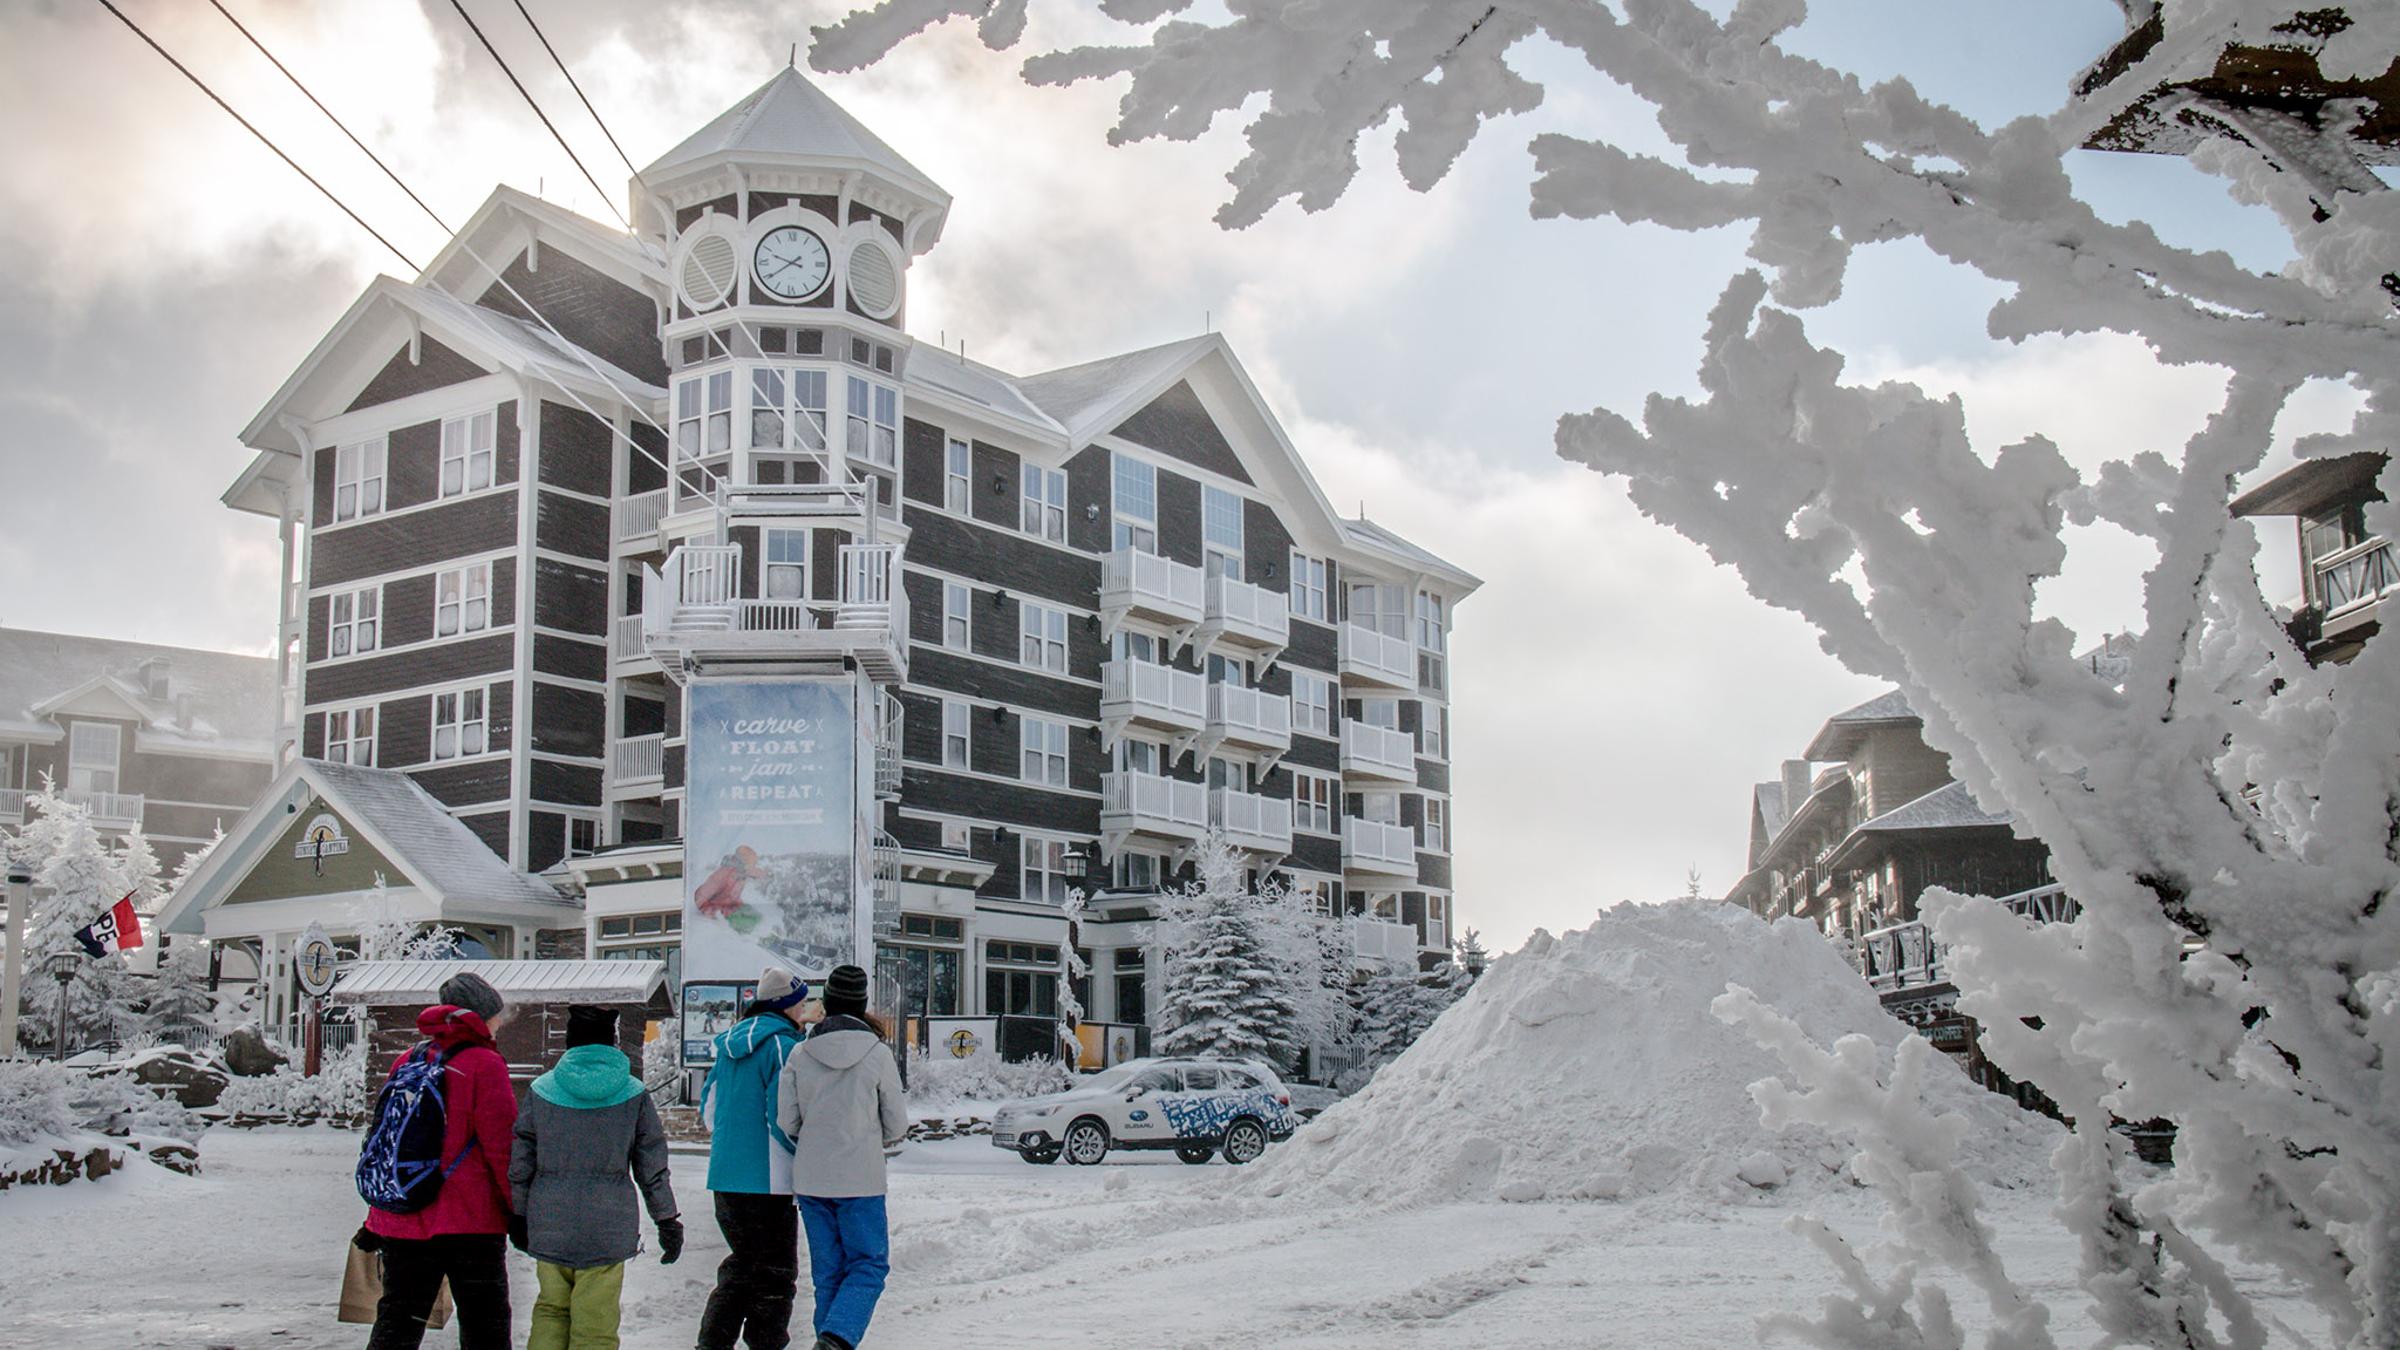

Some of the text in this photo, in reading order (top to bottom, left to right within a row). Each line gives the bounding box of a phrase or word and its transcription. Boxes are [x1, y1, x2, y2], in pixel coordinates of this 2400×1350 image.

[734, 717, 810, 735] carve
[730, 740, 816, 755] FLOAT
[741, 758, 798, 782] jam
[731, 785, 813, 800] REPEAT
[93, 911, 118, 944] PE
